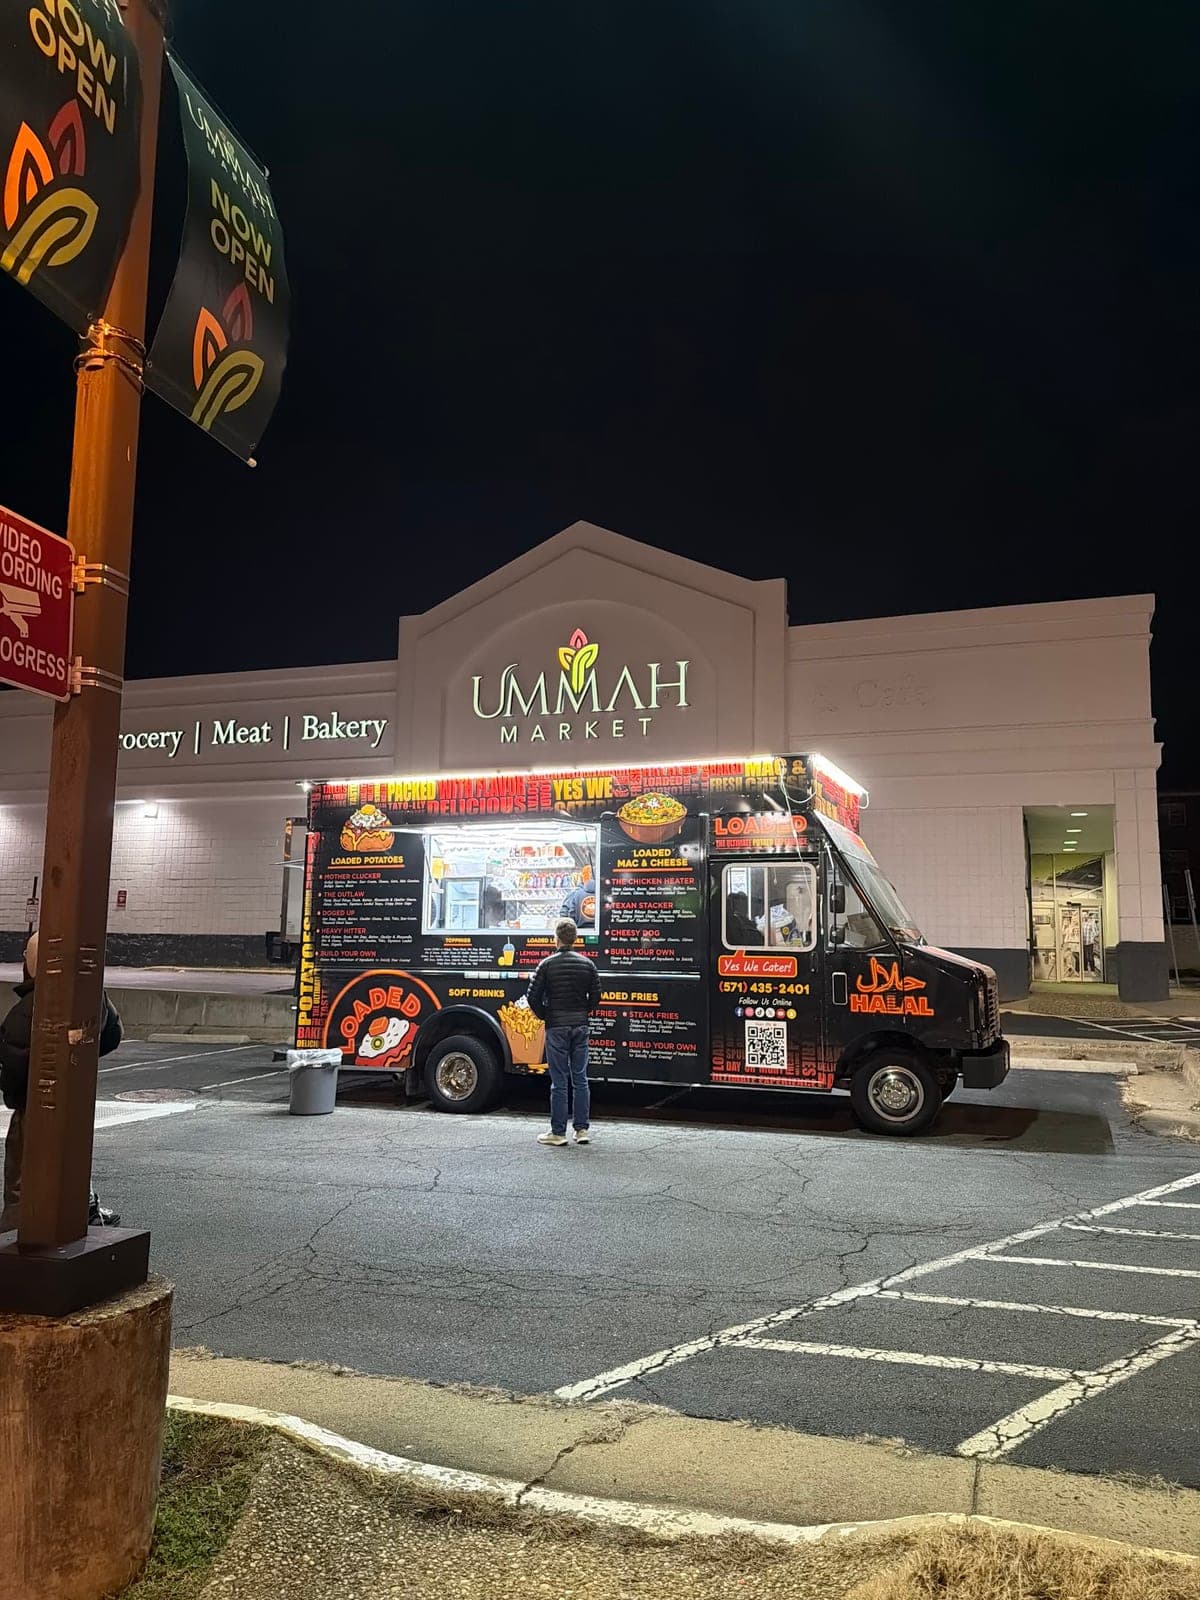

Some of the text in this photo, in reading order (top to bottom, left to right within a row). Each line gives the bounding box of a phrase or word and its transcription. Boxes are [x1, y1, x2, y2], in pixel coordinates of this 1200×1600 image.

[29, 7, 116, 135] OPEN
[210, 178, 272, 266] NOW
[210, 219, 275, 304] OPEN
[1, 554, 63, 600] ORDING
[0, 636, 66, 681] OGRESS
[471, 660, 692, 719] UMMAH
[118, 711, 388, 758] ocery Meat Bakery
[500, 717, 652, 743] MARKET
[744, 757, 807, 778] MAC &
[438, 774, 527, 801] WITH FLAVOR
[553, 777, 584, 801] YES
[586, 775, 613, 799] WE
[642, 775, 683, 787] LOADED
[709, 776, 744, 794] FRESH
[387, 778, 437, 803] PACKED
[426, 795, 528, 817] DELICIOUS
[714, 814, 808, 836] LOADED
[633, 848, 672, 858] LOADED
[330, 855, 404, 866] LOADED POTATOES
[617, 858, 689, 869] MAC & CHEESE
[351, 872, 382, 880] CLUCKER
[611, 877, 696, 886] THE CHICKEN HEATER
[337, 890, 365, 898] OUTLAW
[611, 901, 674, 910] TEXAN STACKER
[611, 929, 661, 937] CHEESY DOG
[319, 950, 339, 958] BUILD
[610, 948, 633, 956] BUILD
[633, 948, 655, 956] YOUR
[297, 915, 315, 1027] POTATOES
[723, 959, 793, 973] Yes We Cater!
[856, 956, 927, 994] حلال
[448, 988, 506, 999] SOFT DRINKS
[718, 981, 811, 995] (571) 435-2401
[600, 991, 659, 1002] ADED FRIES
[738, 995, 793, 1007] Follow Us Online
[850, 993, 935, 1016] HALAL
[337, 985, 422, 1055] LOADED
[596, 1010, 618, 1018] FRIES
[629, 1011, 680, 1020] STEAK FRIES
[588, 1039, 616, 1048] OADED
[628, 1040, 697, 1052] BUILD YOUR OWN
[726, 1061, 742, 1073] DAY
